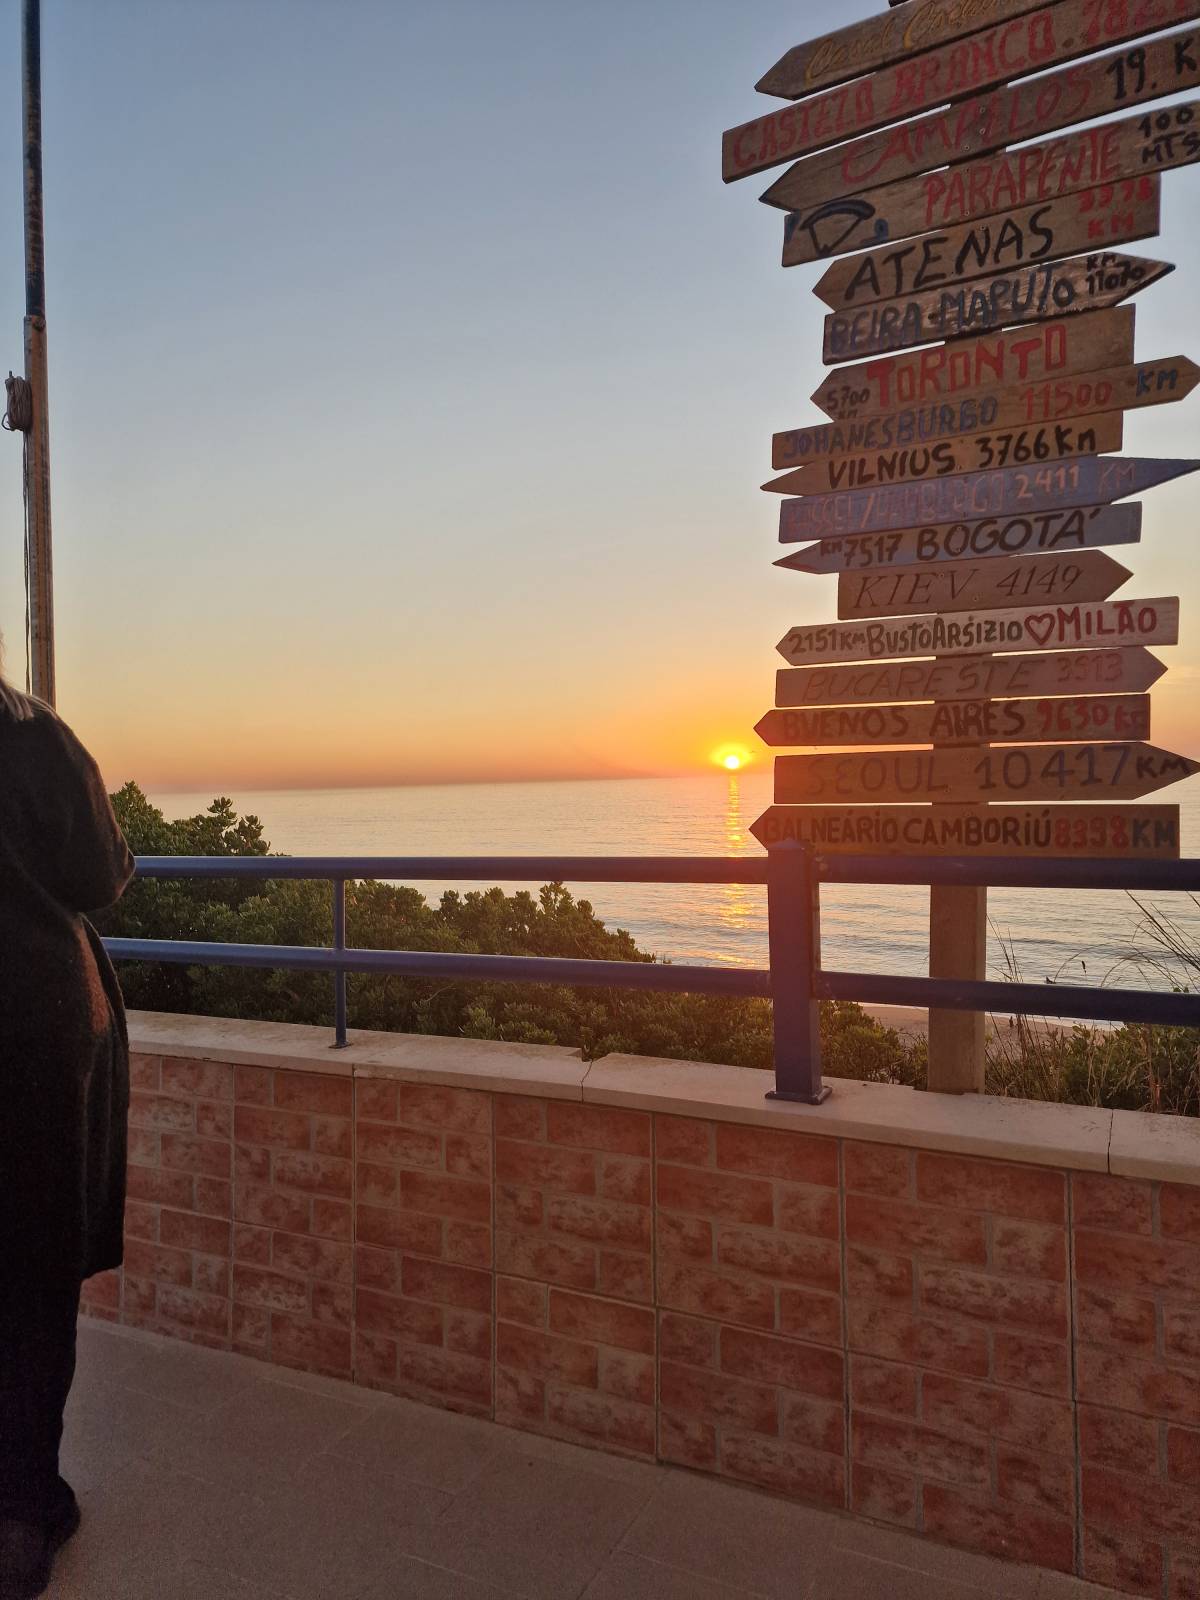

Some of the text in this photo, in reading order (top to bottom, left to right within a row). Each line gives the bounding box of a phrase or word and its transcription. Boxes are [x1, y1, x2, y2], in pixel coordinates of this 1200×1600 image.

[923, 125, 1123, 226] PARAPENTE
[845, 205, 1054, 300] ATENAS
[867, 324, 1067, 408] TORONTO
[1135, 368, 1179, 398] KM
[1014, 464, 1080, 499] 2411
[844, 534, 903, 568] 7517
[853, 564, 1084, 609] KIEV 4149
[782, 708, 909, 739] BUENOS
[928, 701, 1026, 738] AIRES
[805, 756, 949, 795] SEOUL
